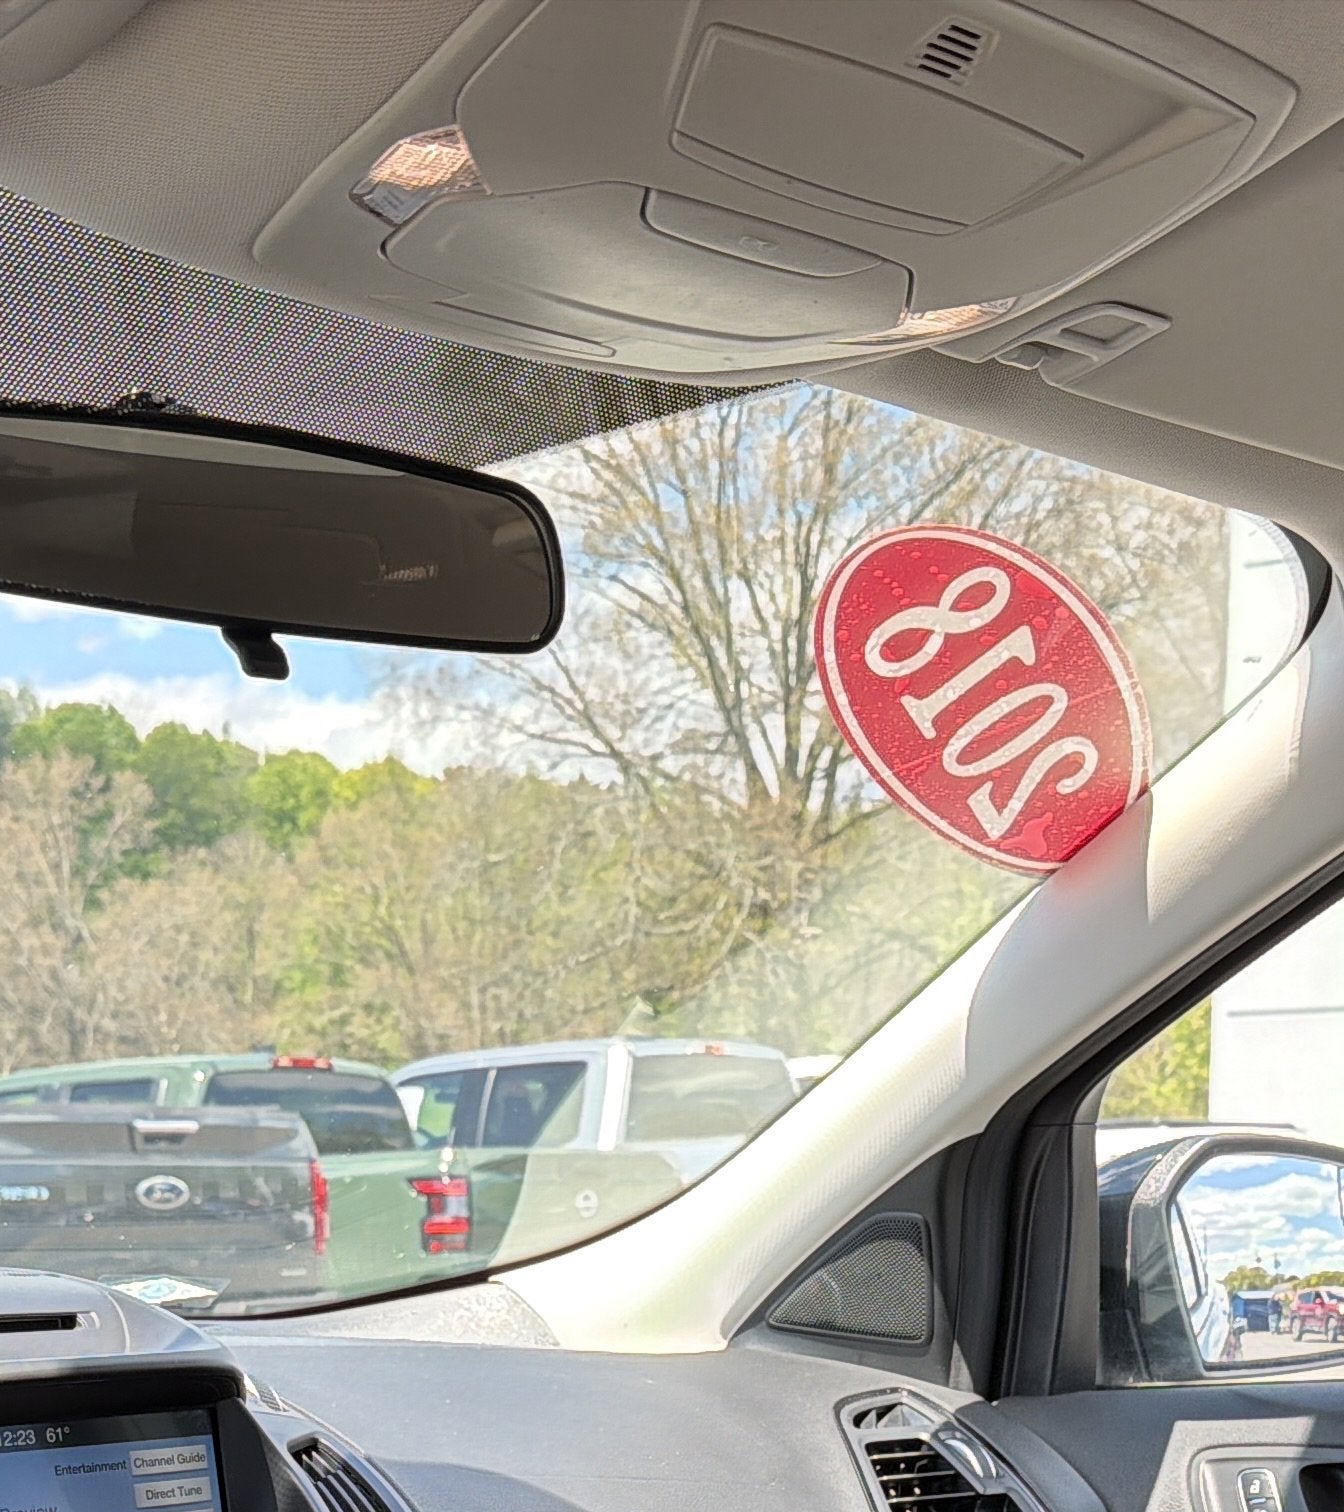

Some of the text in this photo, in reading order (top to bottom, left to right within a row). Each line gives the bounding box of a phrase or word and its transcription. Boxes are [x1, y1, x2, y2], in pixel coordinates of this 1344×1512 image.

[45, 1426, 70, 1443] 61°
[54, 1460, 128, 1476] Entertainment
[133, 1453, 206, 1469] Channel Guide
[145, 1485, 203, 1501] Direct Tune
